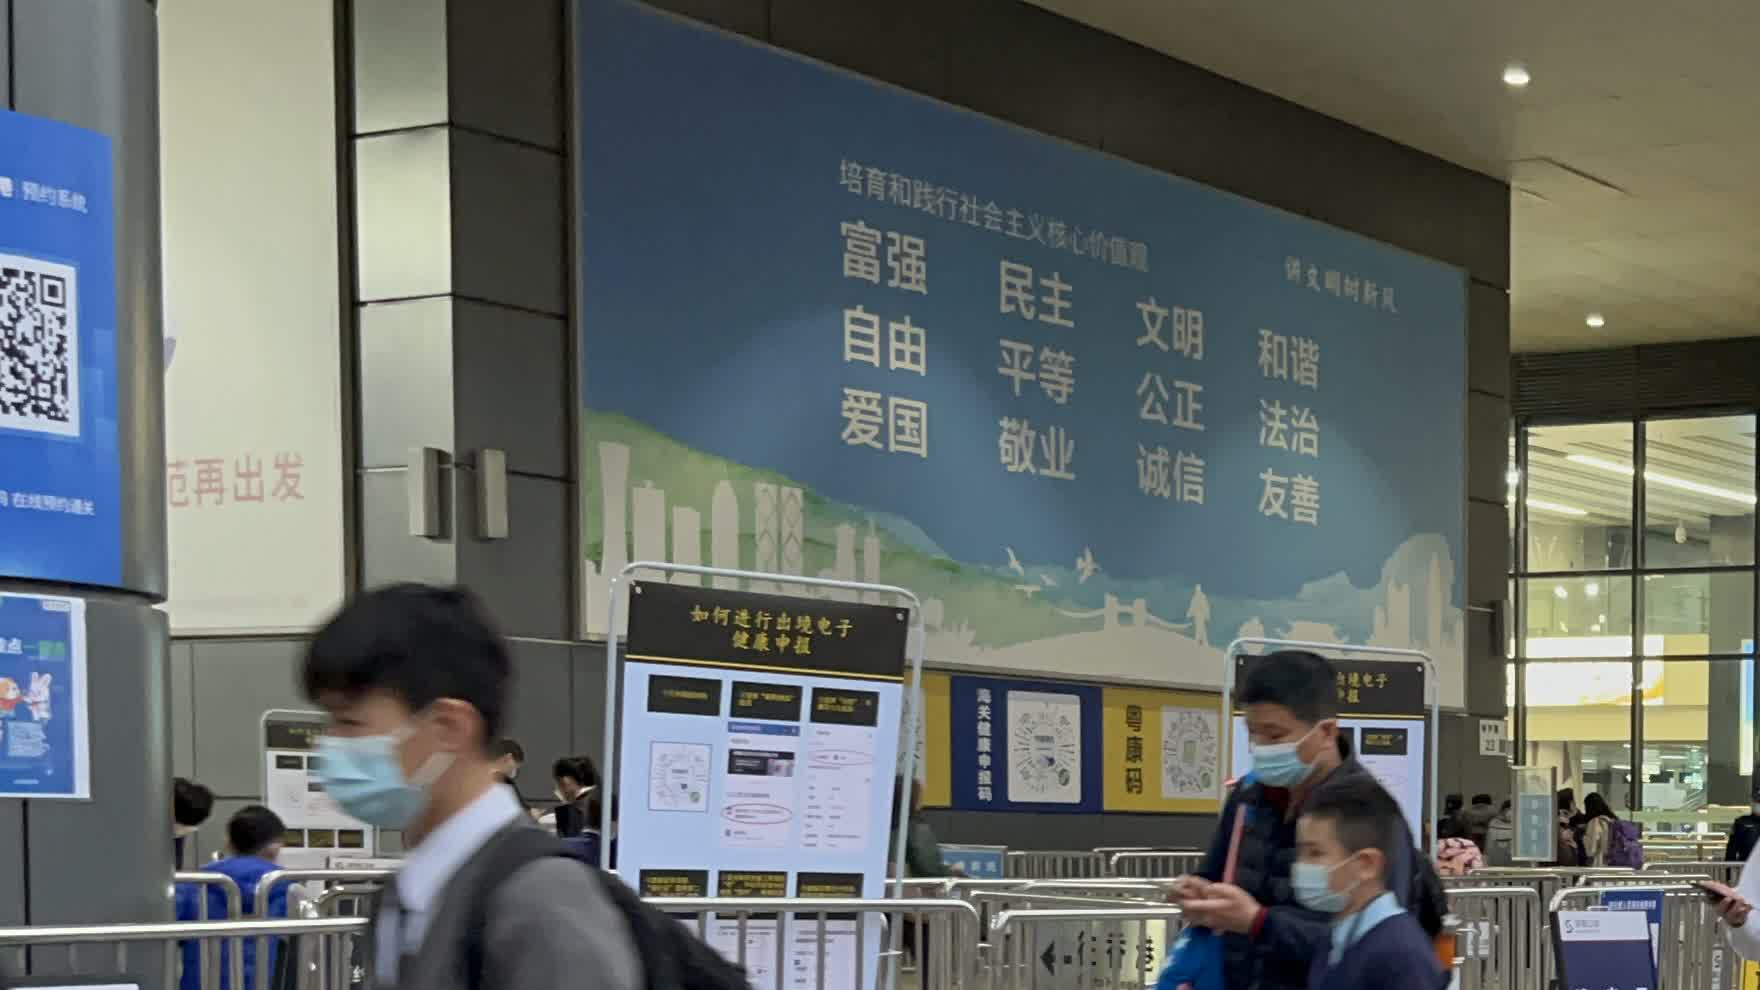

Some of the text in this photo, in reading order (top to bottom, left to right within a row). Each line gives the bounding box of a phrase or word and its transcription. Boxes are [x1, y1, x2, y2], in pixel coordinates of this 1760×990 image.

[840, 221, 1319, 392] 富强 民主 文明 和谐
[842, 304, 1320, 457] 自由 平等 公正 法治
[841, 387, 1319, 526] 爱国 敬业 诚信 友善
[689, 605, 854, 638] 如何进行出境电子
